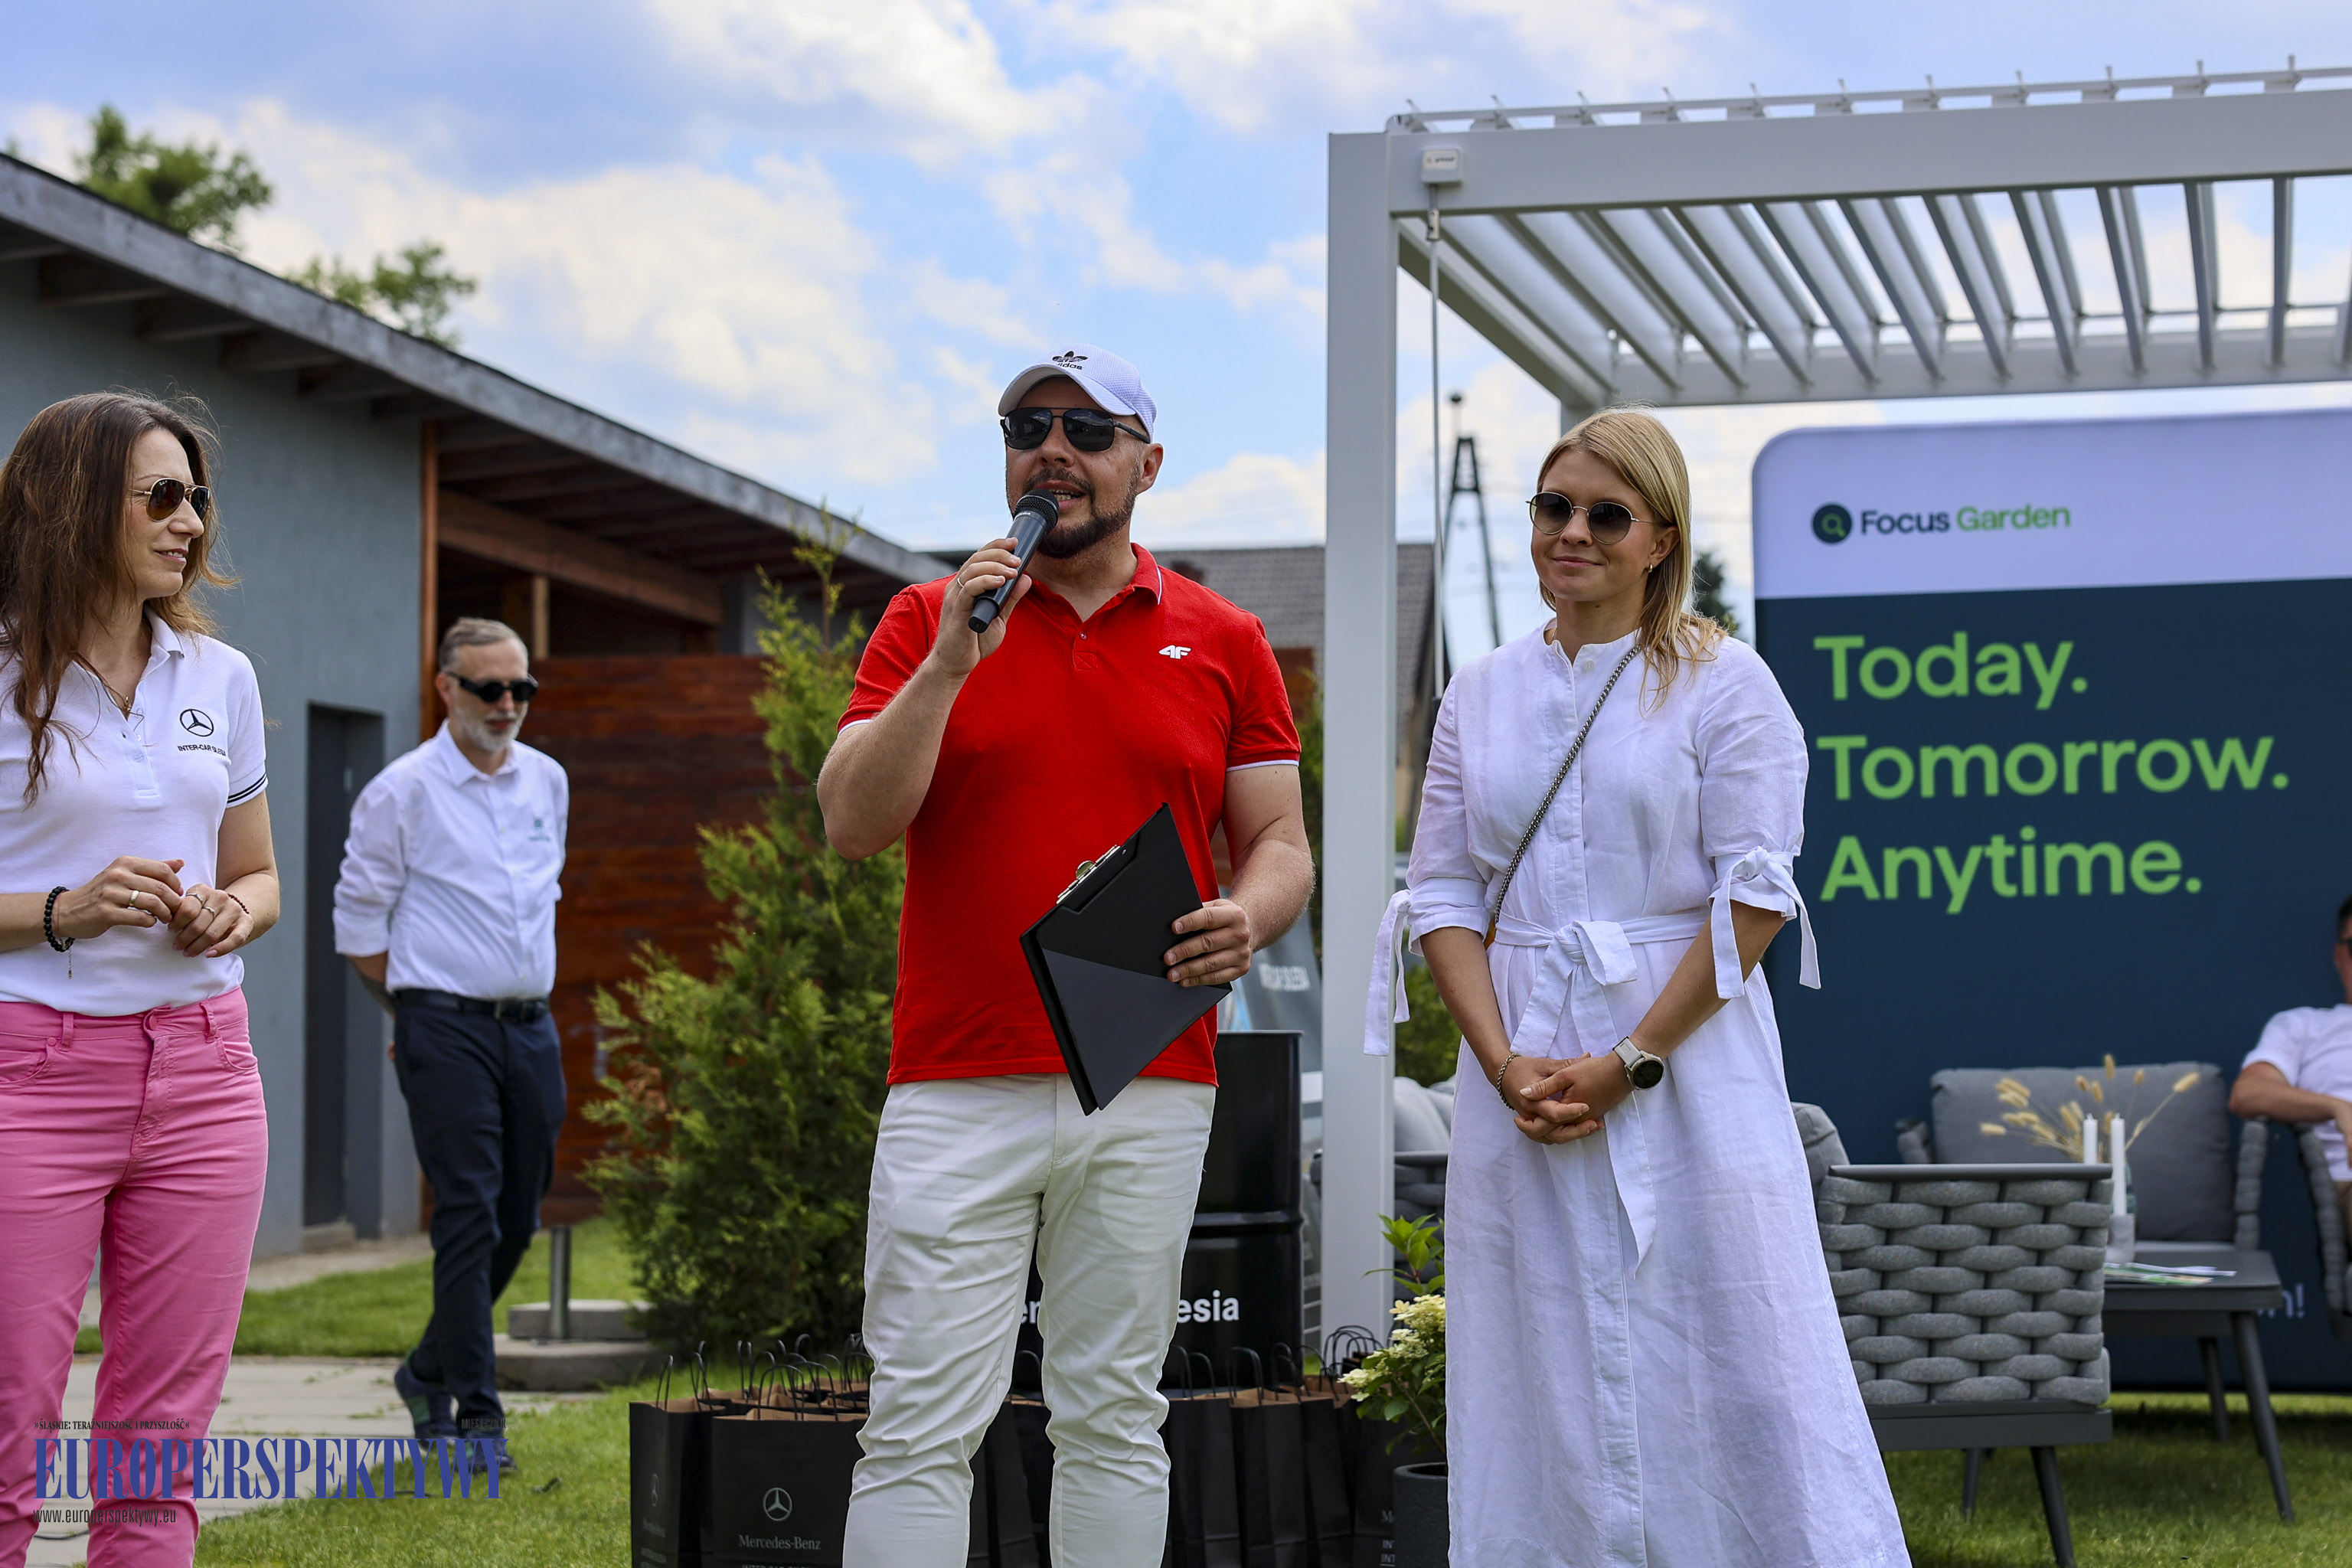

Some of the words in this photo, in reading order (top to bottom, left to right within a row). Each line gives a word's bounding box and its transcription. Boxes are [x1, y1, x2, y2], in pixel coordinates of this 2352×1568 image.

[1860, 509, 1951, 536] Focus
[1955, 502, 2072, 532] Garden
[1158, 645, 1192, 660] 4F
[1813, 631, 2088, 710] Today.
[1816, 736, 2289, 801] Tomorrow.
[1819, 825, 2203, 915] Anytime.
[739, 1534, 821, 1550] Mercedes-Benz
